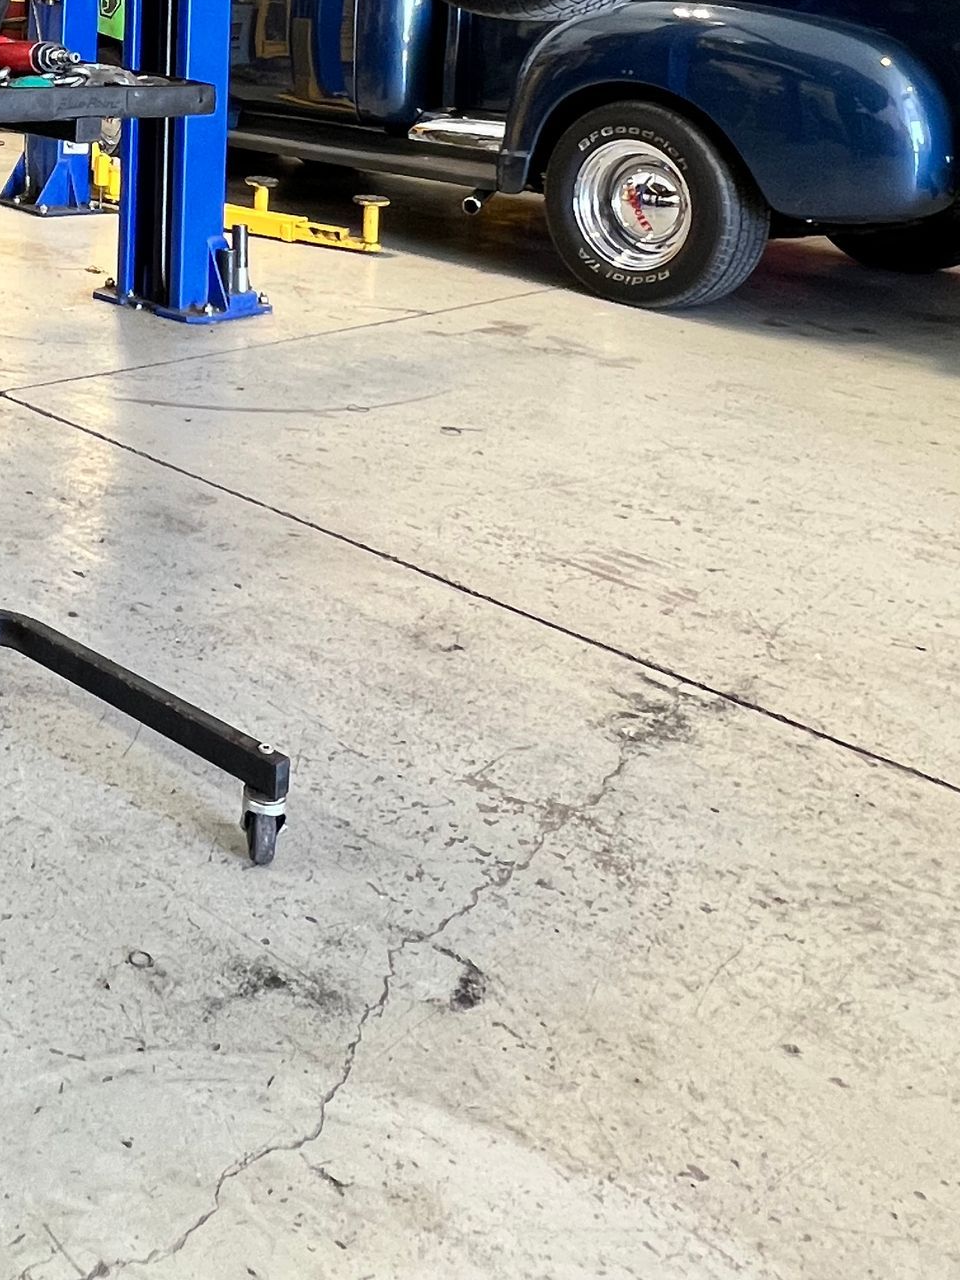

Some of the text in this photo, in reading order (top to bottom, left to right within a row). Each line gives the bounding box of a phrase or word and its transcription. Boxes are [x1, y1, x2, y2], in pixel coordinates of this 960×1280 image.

[577, 125, 689, 171] BFGoodrich
[578, 247, 671, 286] Radial T/A
